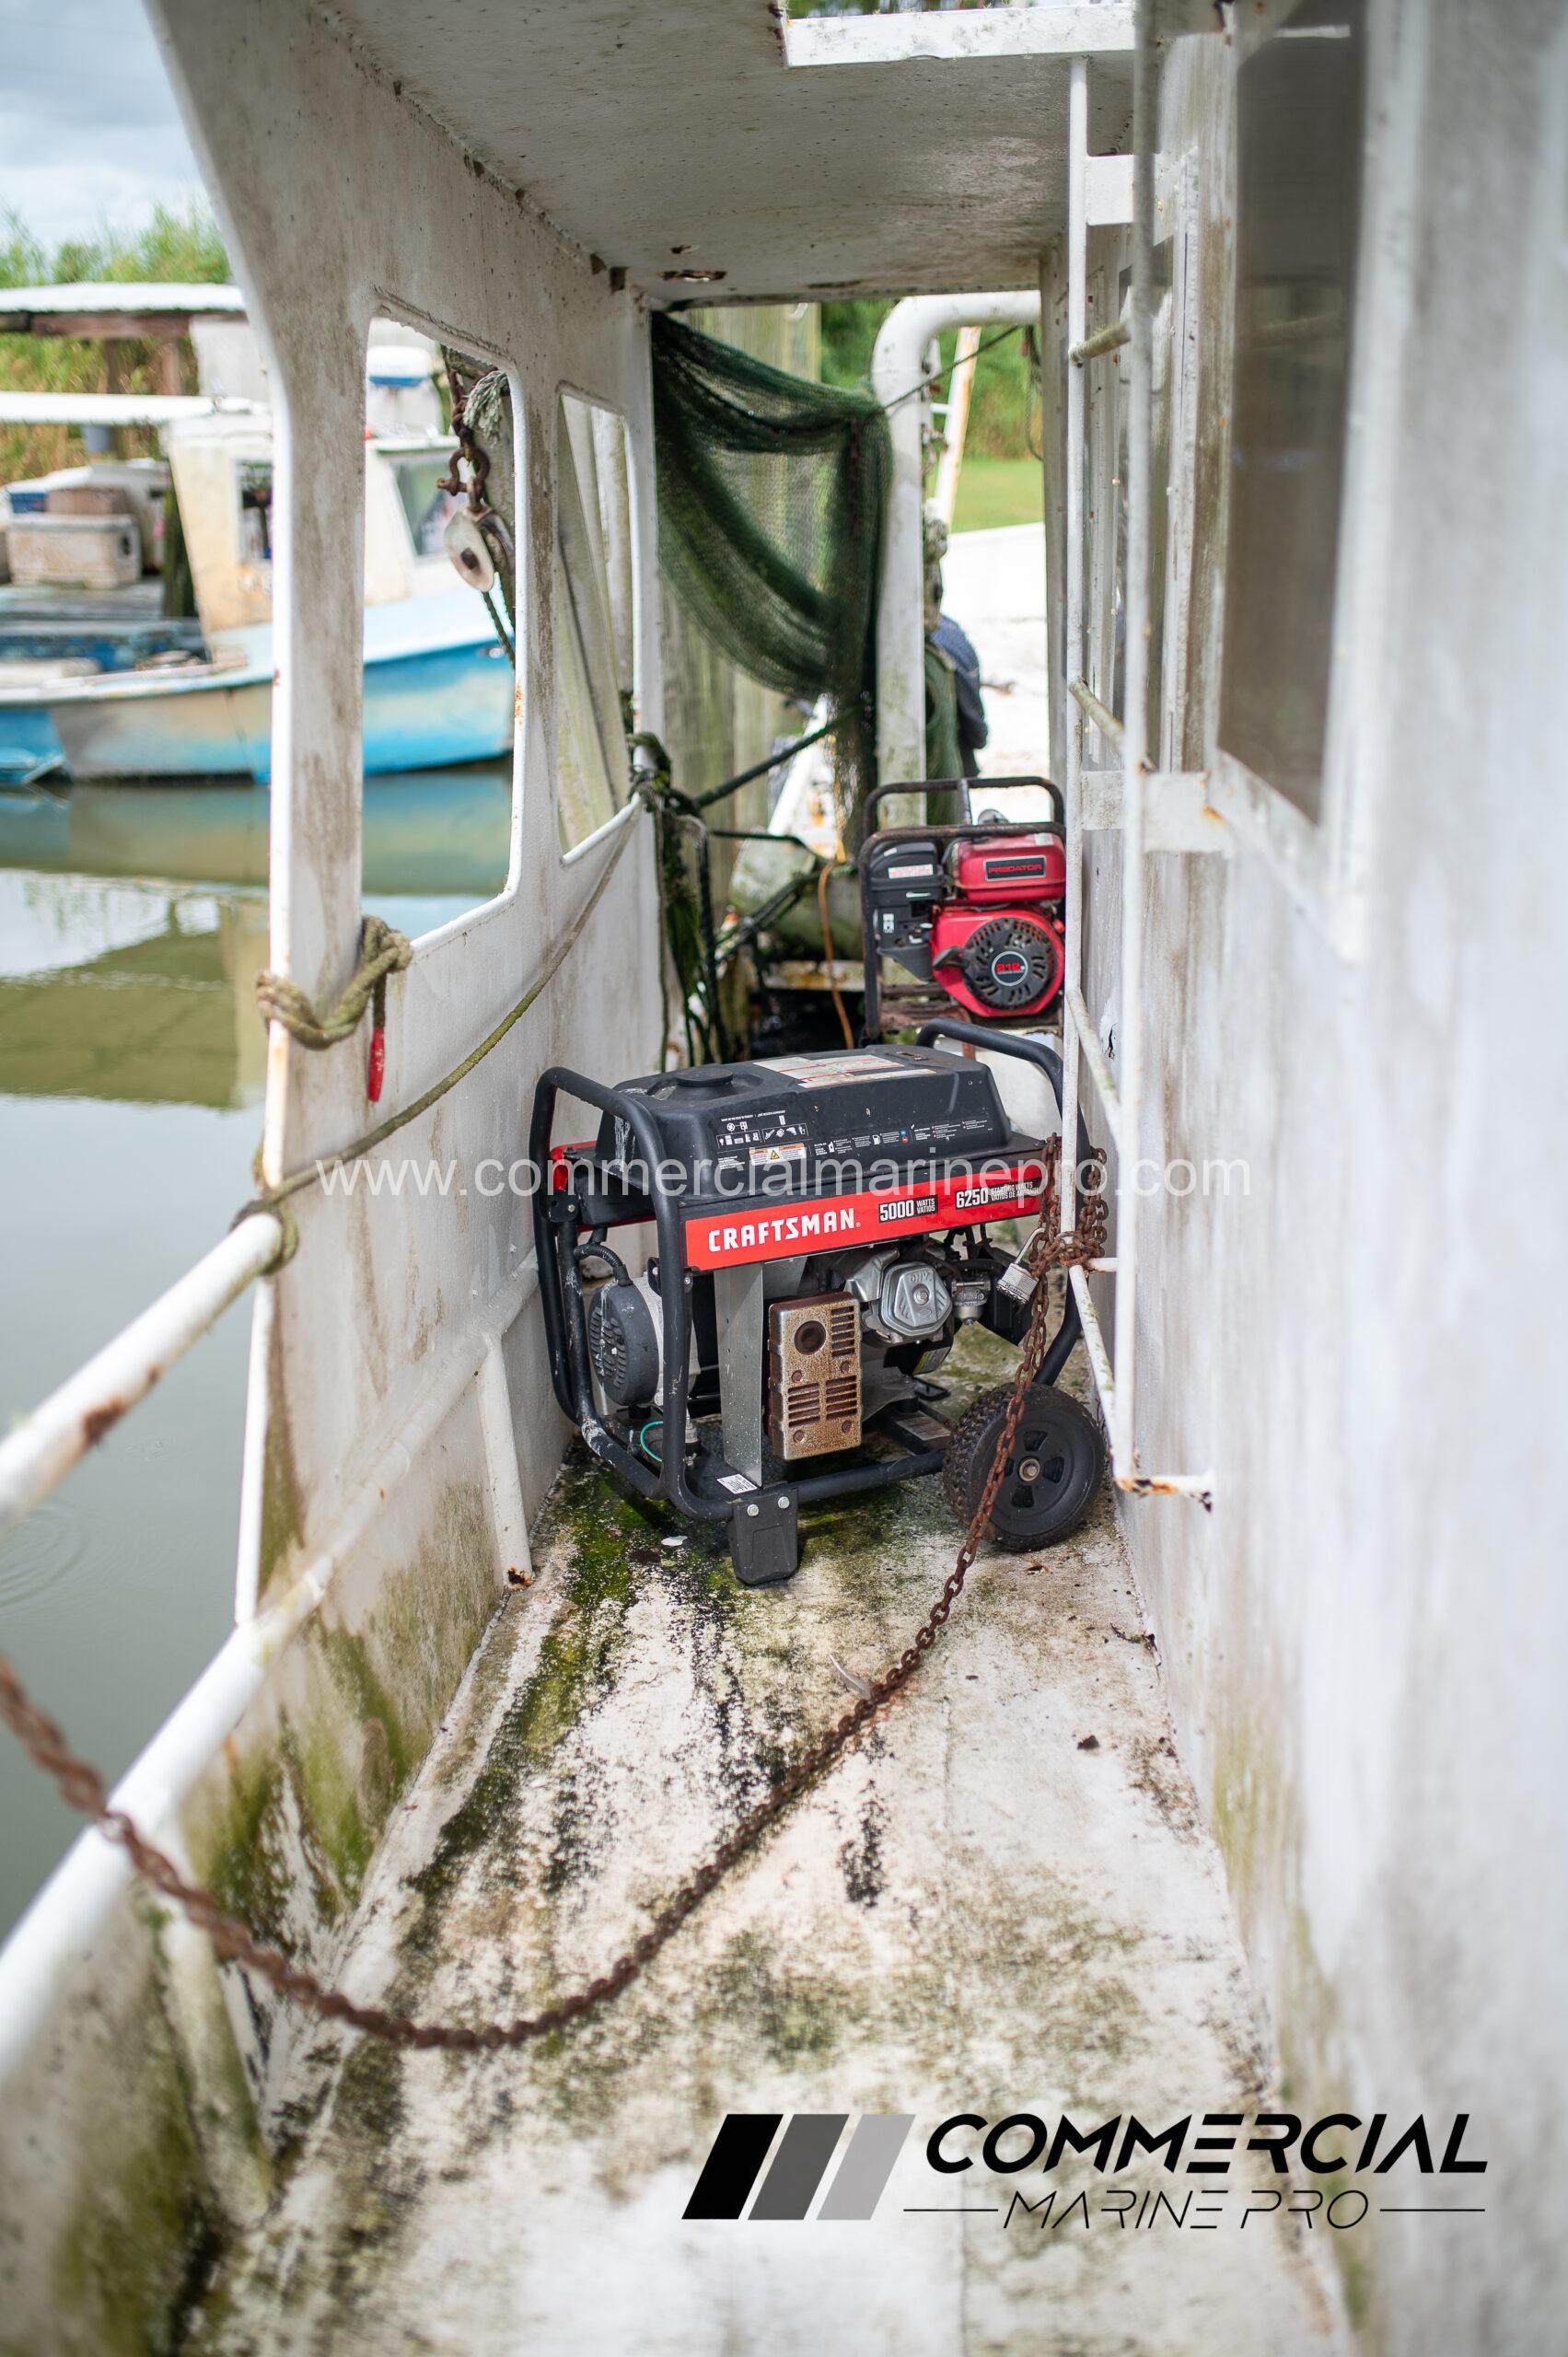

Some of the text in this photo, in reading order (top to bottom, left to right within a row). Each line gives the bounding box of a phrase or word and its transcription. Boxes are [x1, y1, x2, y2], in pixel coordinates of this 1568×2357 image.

[956, 1187, 989, 1208] 6250
[879, 1198, 935, 1222] 5000 WATTS
[916, 1205, 935, 1213] VATIOS
[708, 1207, 855, 1253] CRAFTSMAN
